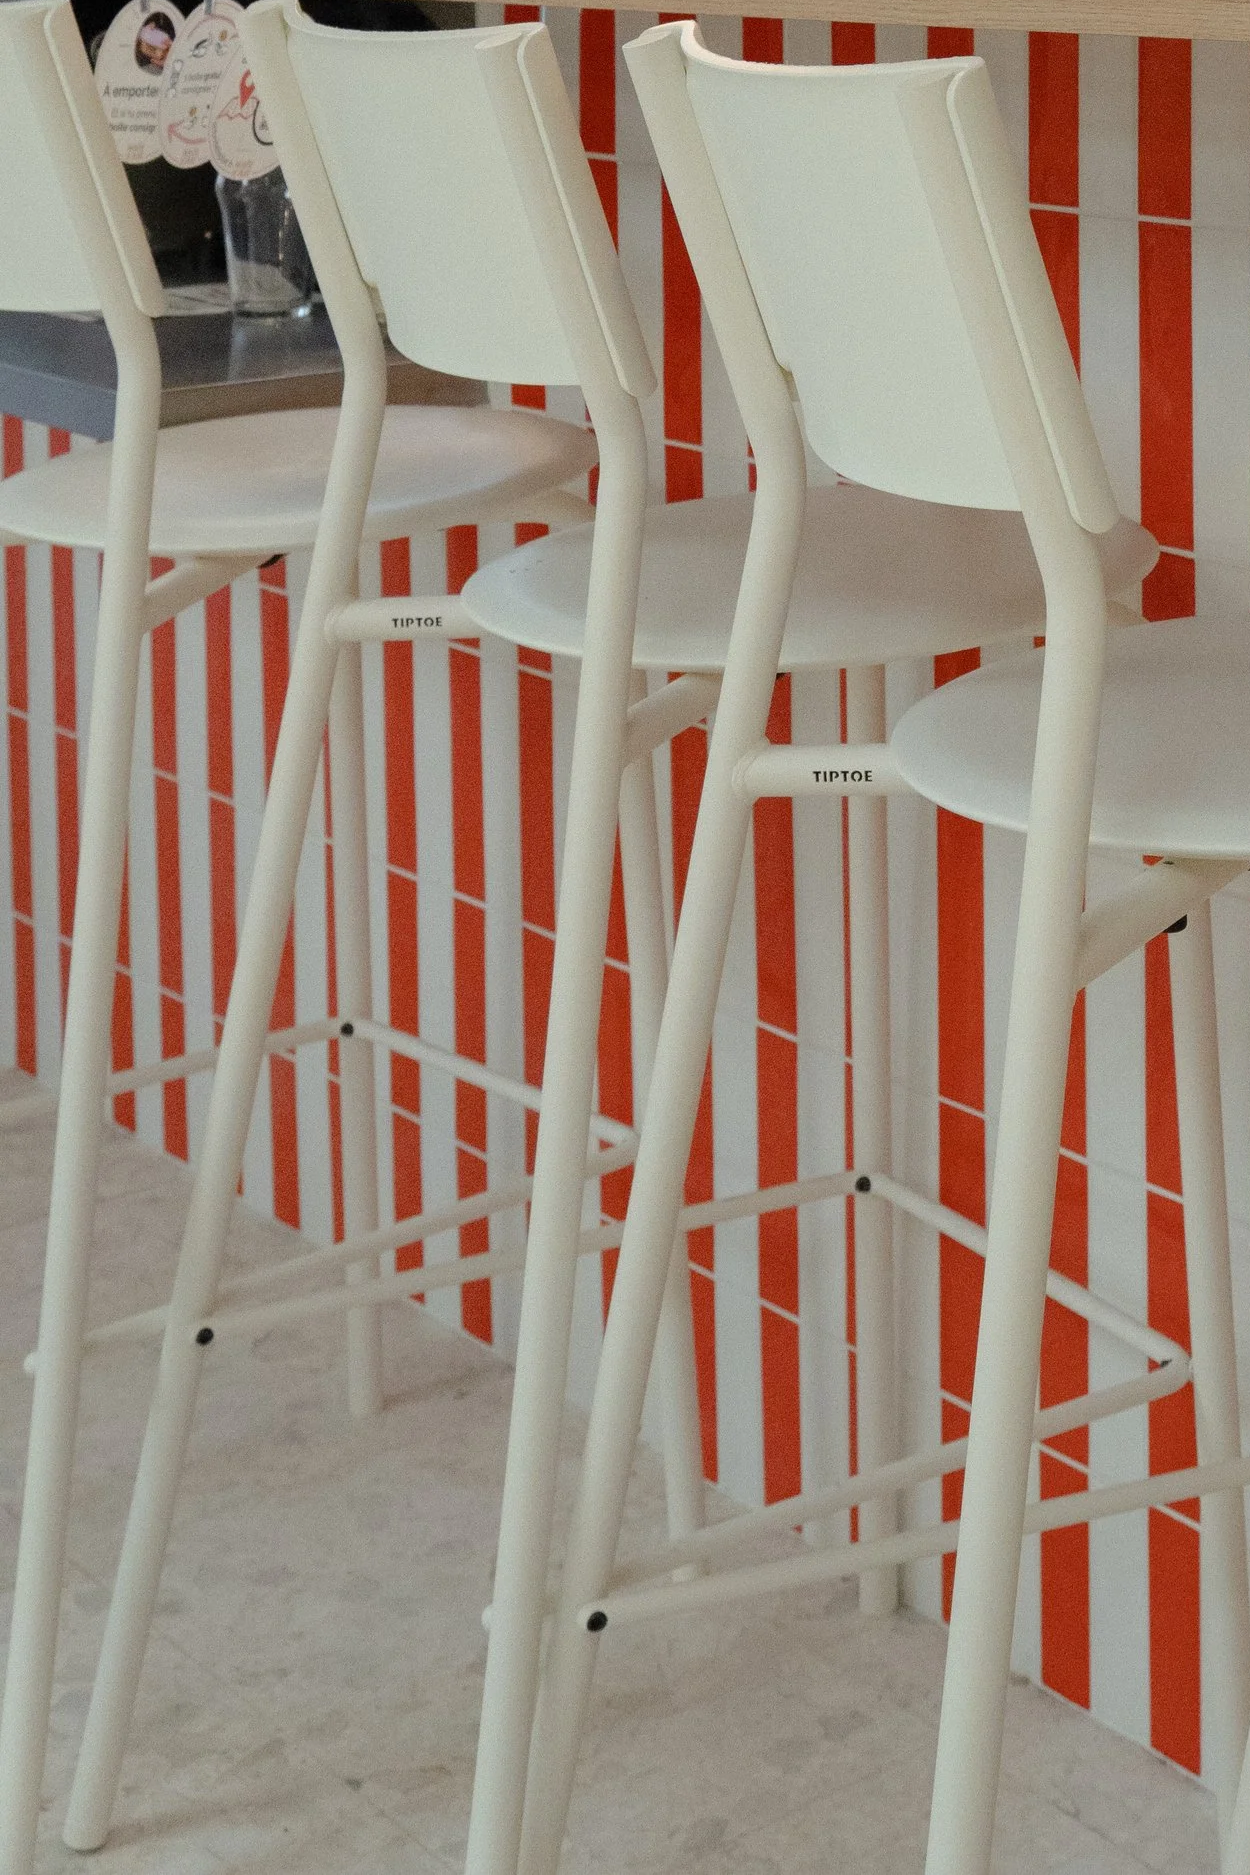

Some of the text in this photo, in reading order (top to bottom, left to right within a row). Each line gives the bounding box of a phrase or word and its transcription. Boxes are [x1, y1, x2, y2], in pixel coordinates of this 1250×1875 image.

[113, 86, 160, 99] emporte
[391, 616, 443, 629] TIPTOE
[813, 770, 873, 783] TIPTOE
